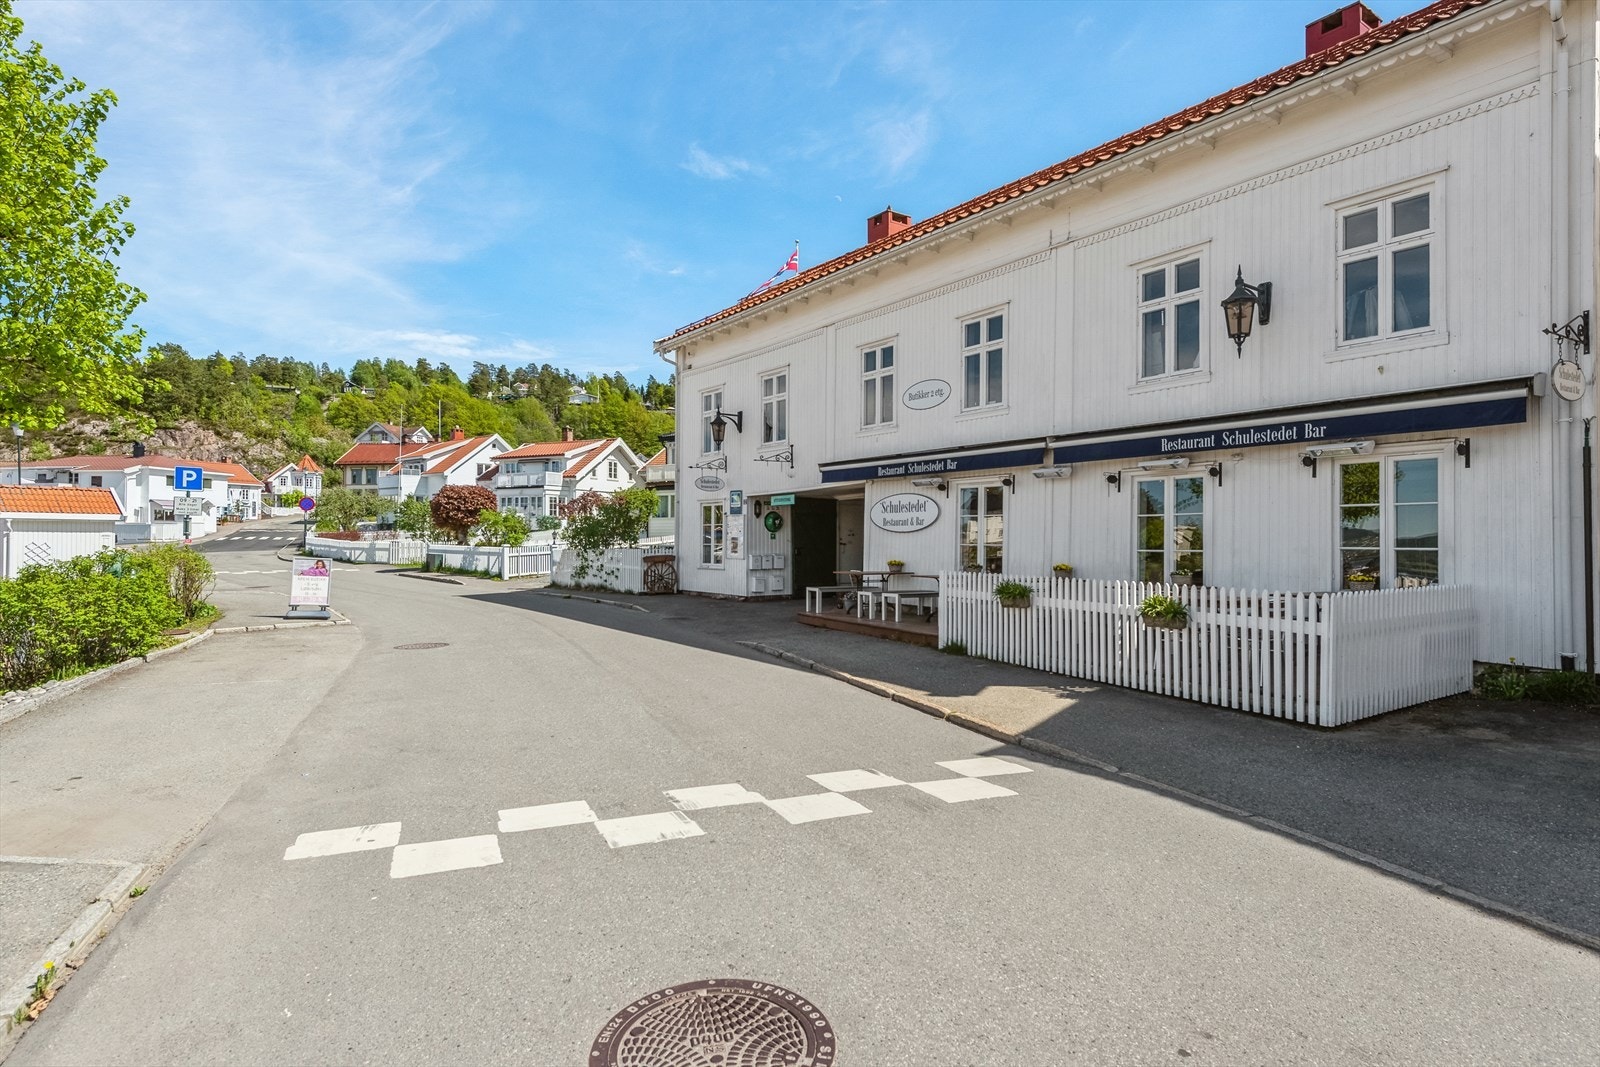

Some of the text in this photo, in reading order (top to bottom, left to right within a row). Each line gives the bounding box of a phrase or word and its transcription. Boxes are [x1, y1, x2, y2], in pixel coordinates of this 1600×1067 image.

[908, 390, 930, 401] Butikker
[934, 388, 945, 398] etg.
[1161, 423, 1327, 452] Restaurant Schulestedet Bar
[877, 459, 958, 477] Restaurant Schulestedet Bar
[182, 470, 197, 487] P
[882, 516, 925, 527] Restaurant & Bar
